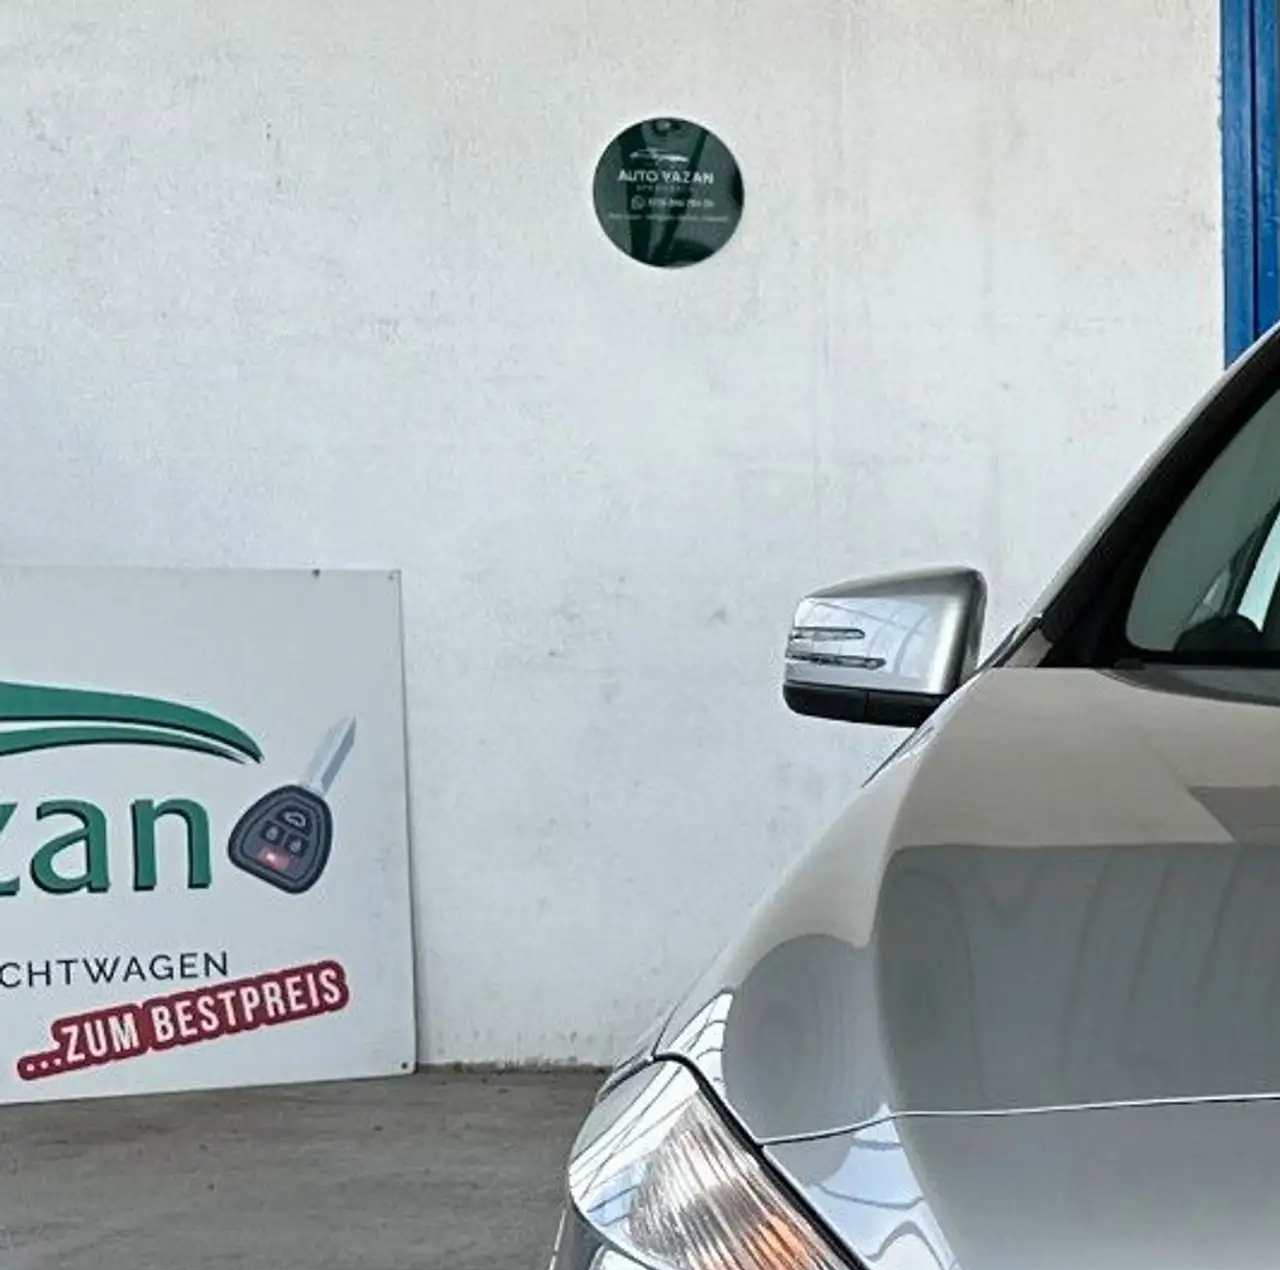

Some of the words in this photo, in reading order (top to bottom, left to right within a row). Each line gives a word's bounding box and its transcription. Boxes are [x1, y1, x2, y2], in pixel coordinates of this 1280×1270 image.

[616, 169, 660, 183] AUTO
[661, 170, 715, 185] YAZAN
[0, 950, 229, 988] CHTWAGEN
[150, 967, 343, 1044] BESTPREIS
